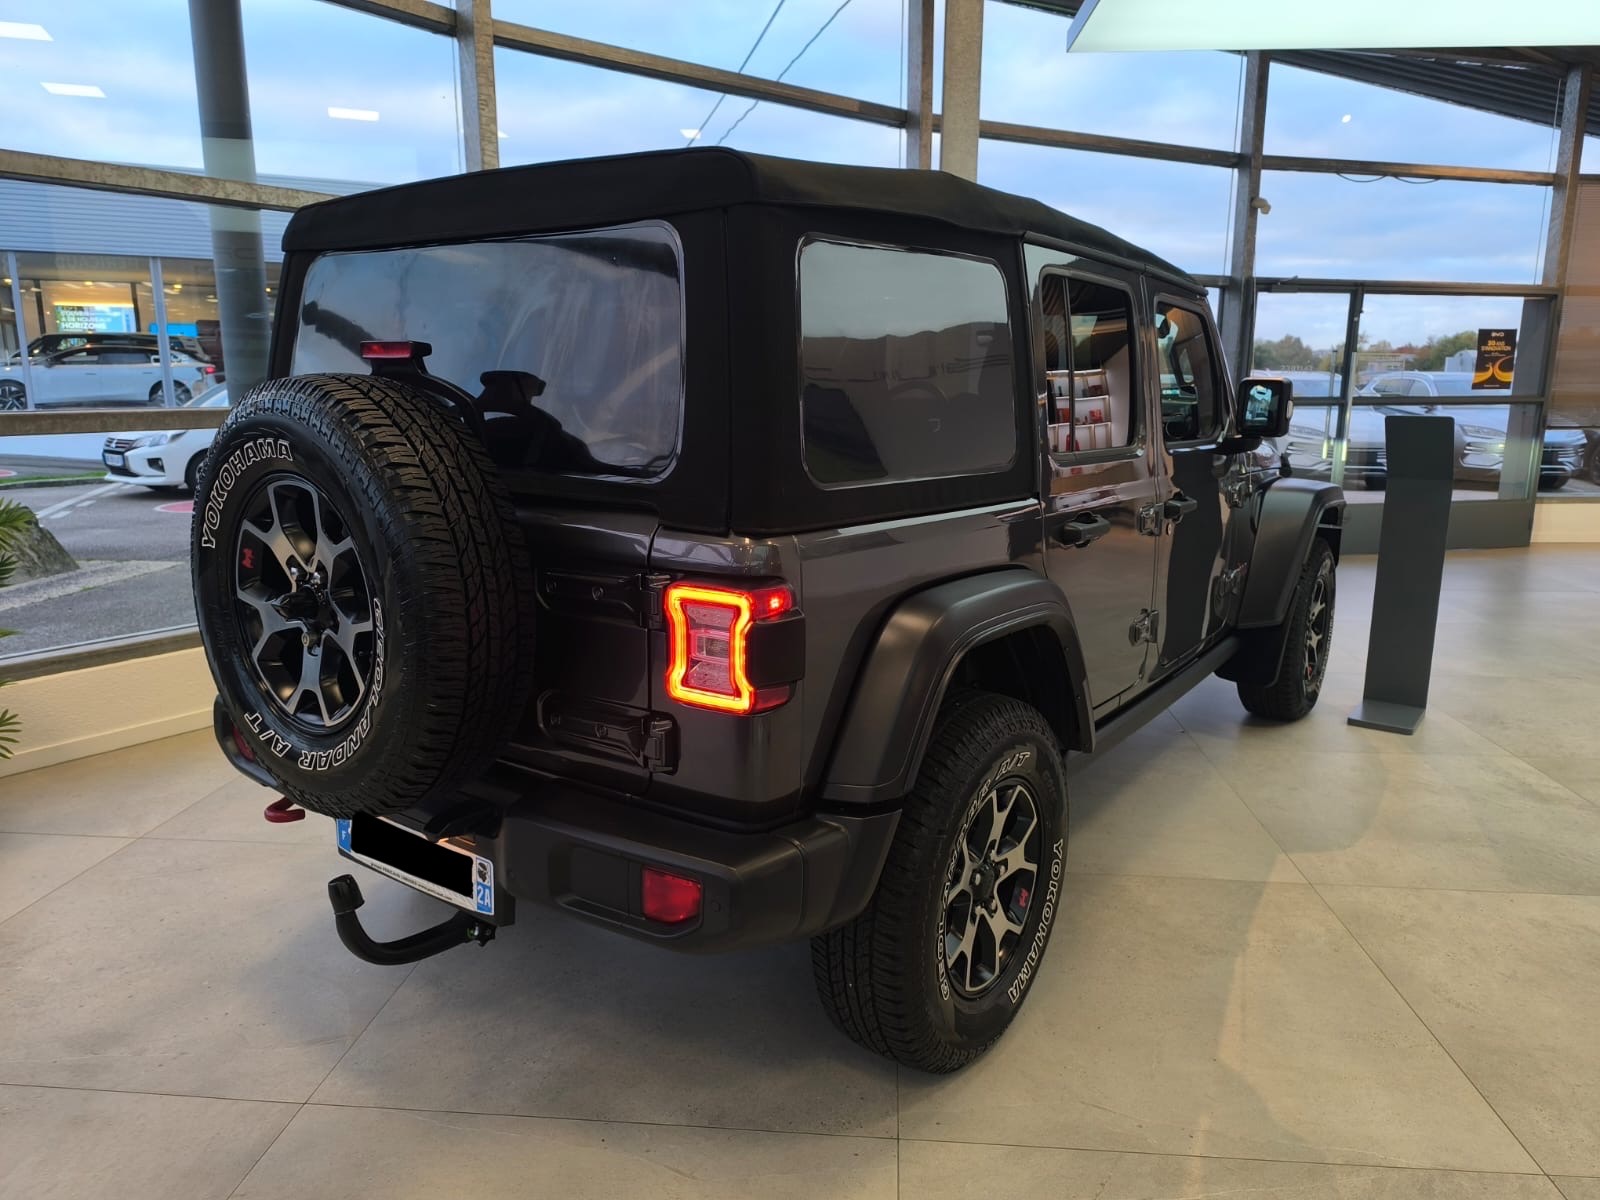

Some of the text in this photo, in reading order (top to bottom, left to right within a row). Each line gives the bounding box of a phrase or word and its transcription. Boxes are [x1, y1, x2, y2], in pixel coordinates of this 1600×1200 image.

[202, 438, 293, 549] YOKOHAMA
[244, 597, 385, 771] GEOLANDAR A/T
[995, 751, 1031, 781] A/T
[341, 830, 347, 841] F
[477, 884, 491, 908] 2A
[1007, 838, 1064, 1004] YOKOHAMA
